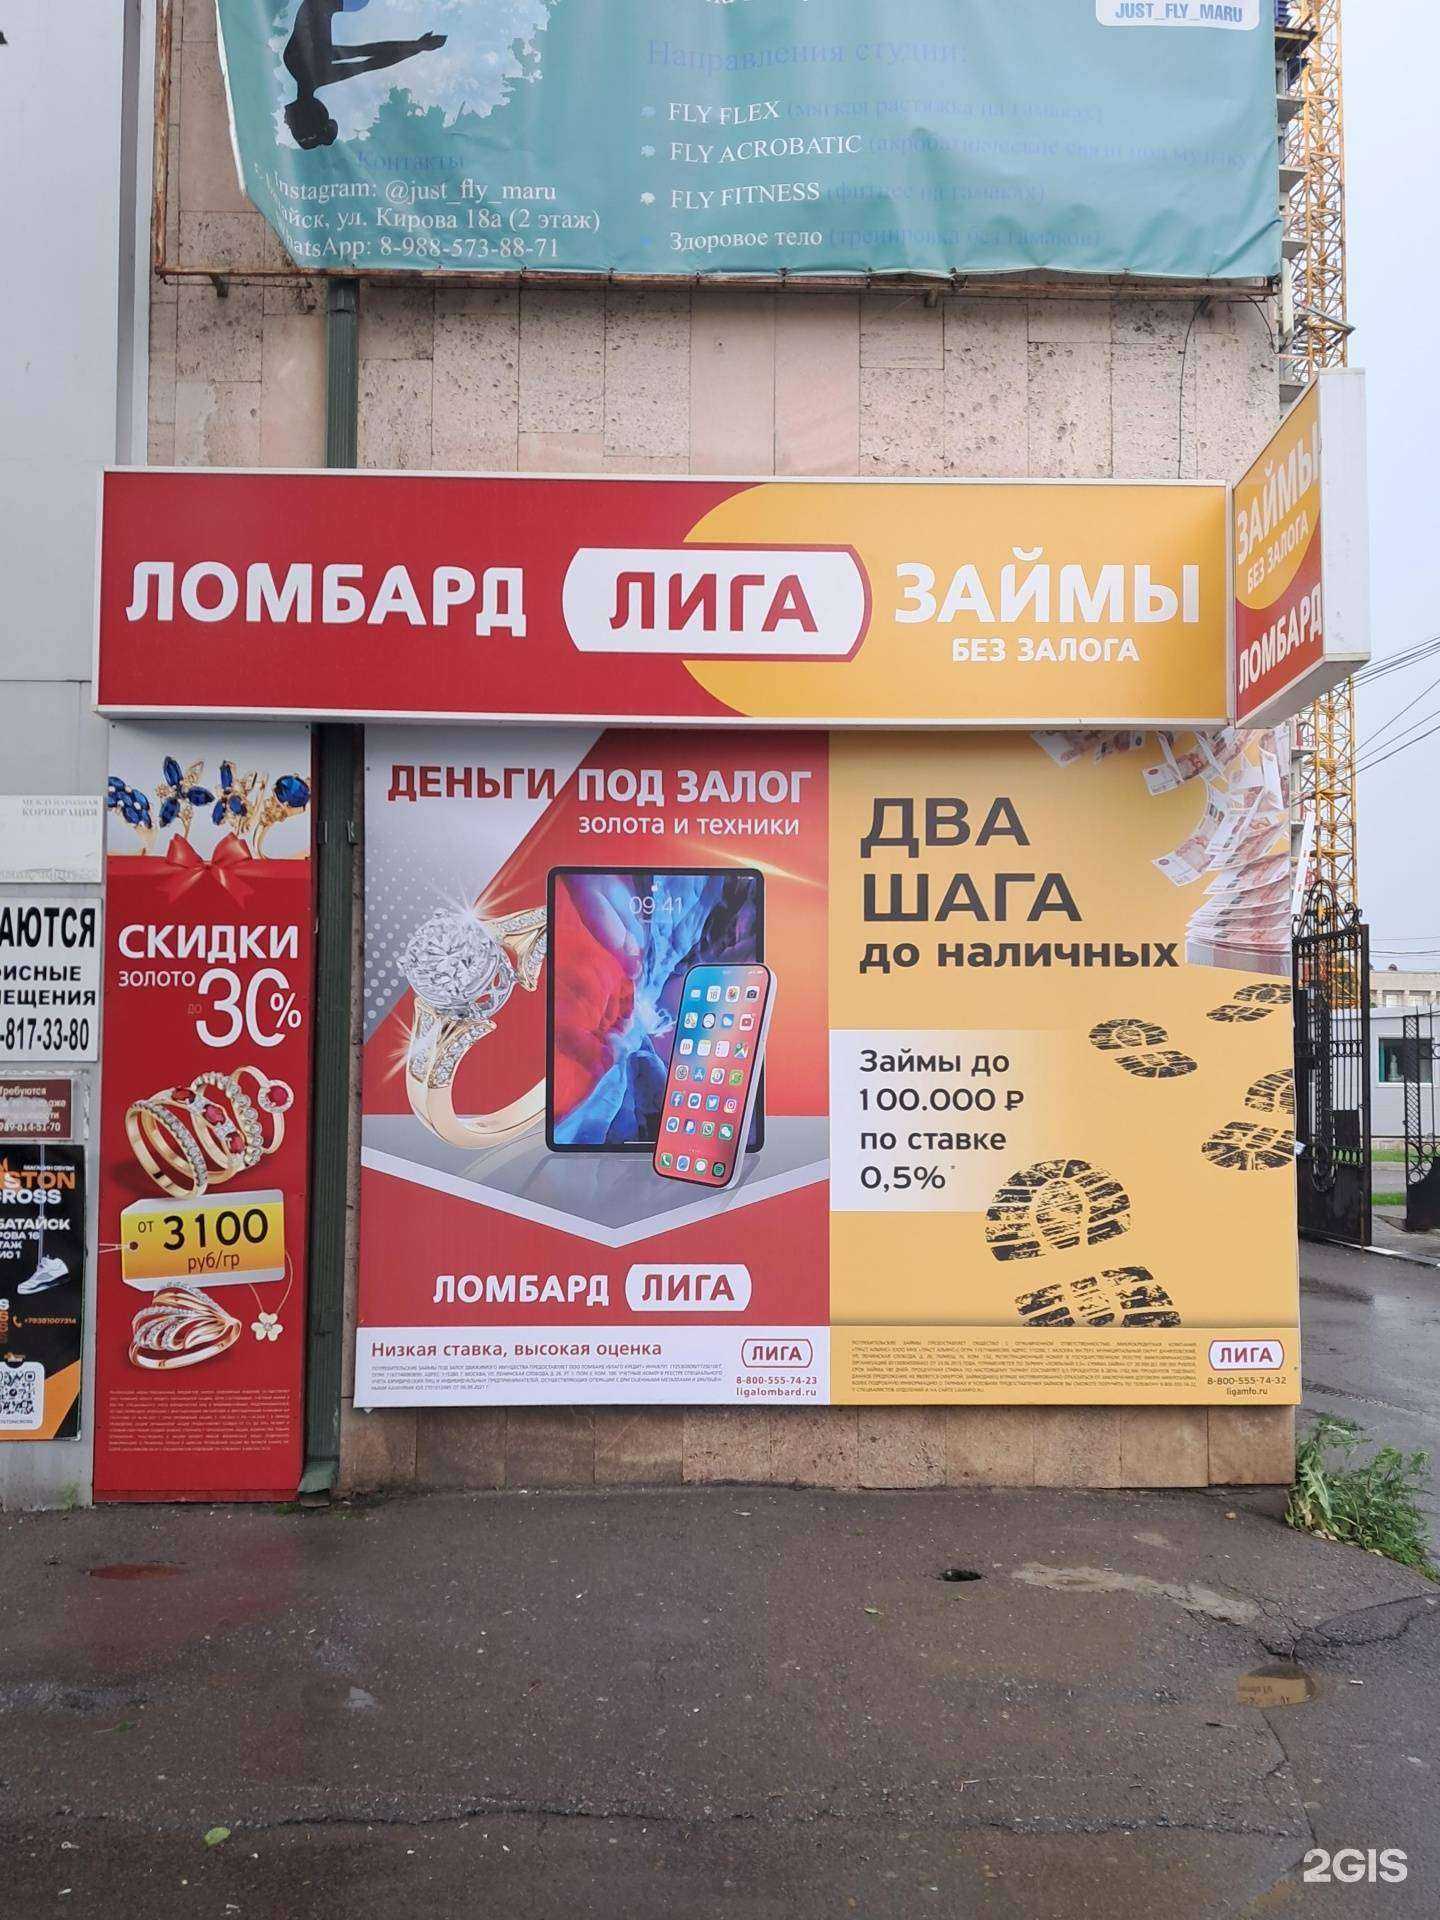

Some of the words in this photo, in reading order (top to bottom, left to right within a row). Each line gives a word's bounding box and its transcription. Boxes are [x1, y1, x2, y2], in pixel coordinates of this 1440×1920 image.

[1115, 3, 1242, 22] JUST_FLY_MARU
[668, 102, 713, 123] FLY
[719, 100, 784, 125] FLEX
[669, 142, 717, 164] FLY
[719, 135, 863, 164] ACROBATIC
[385, 177, 557, 205] @just_fly_maru
[671, 190, 714, 209] FLY
[720, 182, 821, 206] FITNESS
[337, 212, 367, 231] ул.
[376, 208, 458, 231] Кирова
[509, 208, 530, 231] (2
[537, 208, 601, 231] этаж)
[380, 237, 558, 258] 8-988-573-88-71
[670, 231, 768, 252] Здоровое
[774, 231, 823, 247] тело
[1237, 421, 1321, 565] ЗАЙМЫ
[1247, 554, 1265, 594] БЕЗ
[1266, 510, 1309, 573] ЗАЛОГА
[895, 547, 1200, 624] ЗАЙМЫ
[125, 561, 528, 637] ЛОМБАРД
[609, 571, 818, 634] ЛИГА
[952, 638, 1007, 663] БЕЗ
[1016, 637, 1141, 663] ЗАЛОГА
[1238, 582, 1323, 694] ЛОМБАРД
[387, 765, 556, 802] ДЕНЬГИ
[577, 768, 665, 807] ПОД
[676, 769, 812, 804] ЗАЛОГ
[578, 814, 665, 834] золота
[674, 816, 689, 834] и
[696, 815, 800, 836] техники
[860, 797, 1031, 859] ДВА
[863, 872, 1082, 923] ШАГА
[0, 906, 96, 948] АЮТСЯ
[118, 924, 299, 964] СКИДКИ
[859, 942, 921, 975] до
[937, 942, 1180, 969] наличных
[0, 965, 82, 982] ИСНЫЕ
[0, 989, 96, 1008] ЕЩЕНИЯ
[859, 1048, 961, 1073] Займы
[970, 1055, 1010, 1077] до
[859, 1088, 996, 1112] 100.000
[860, 1132, 897, 1150] по
[908, 1132, 1007, 1150] ставке
[0, 1171, 76, 1189] STON
[0, 1189, 62, 1204] ROSS
[163, 1208, 268, 1251] 3100
[187, 1250, 241, 1273] руб/гр
[432, 1274, 610, 1306] ЛОМБАРД
[642, 1274, 735, 1302] ЛИГА
[371, 1343, 437, 1357] Низкая
[443, 1344, 507, 1358] ставка,
[514, 1344, 590, 1356] высокая
[597, 1344, 662, 1357] оценка
[752, 1346, 802, 1361] ЛИГА
[1220, 1347, 1273, 1363] ЛИГА
[736, 1376, 817, 1385] 8-800-555-74-23
[736, 1387, 817, 1398] ligalombard.ru
[1207, 1376, 1287, 1385] 8-800-555-74-32
